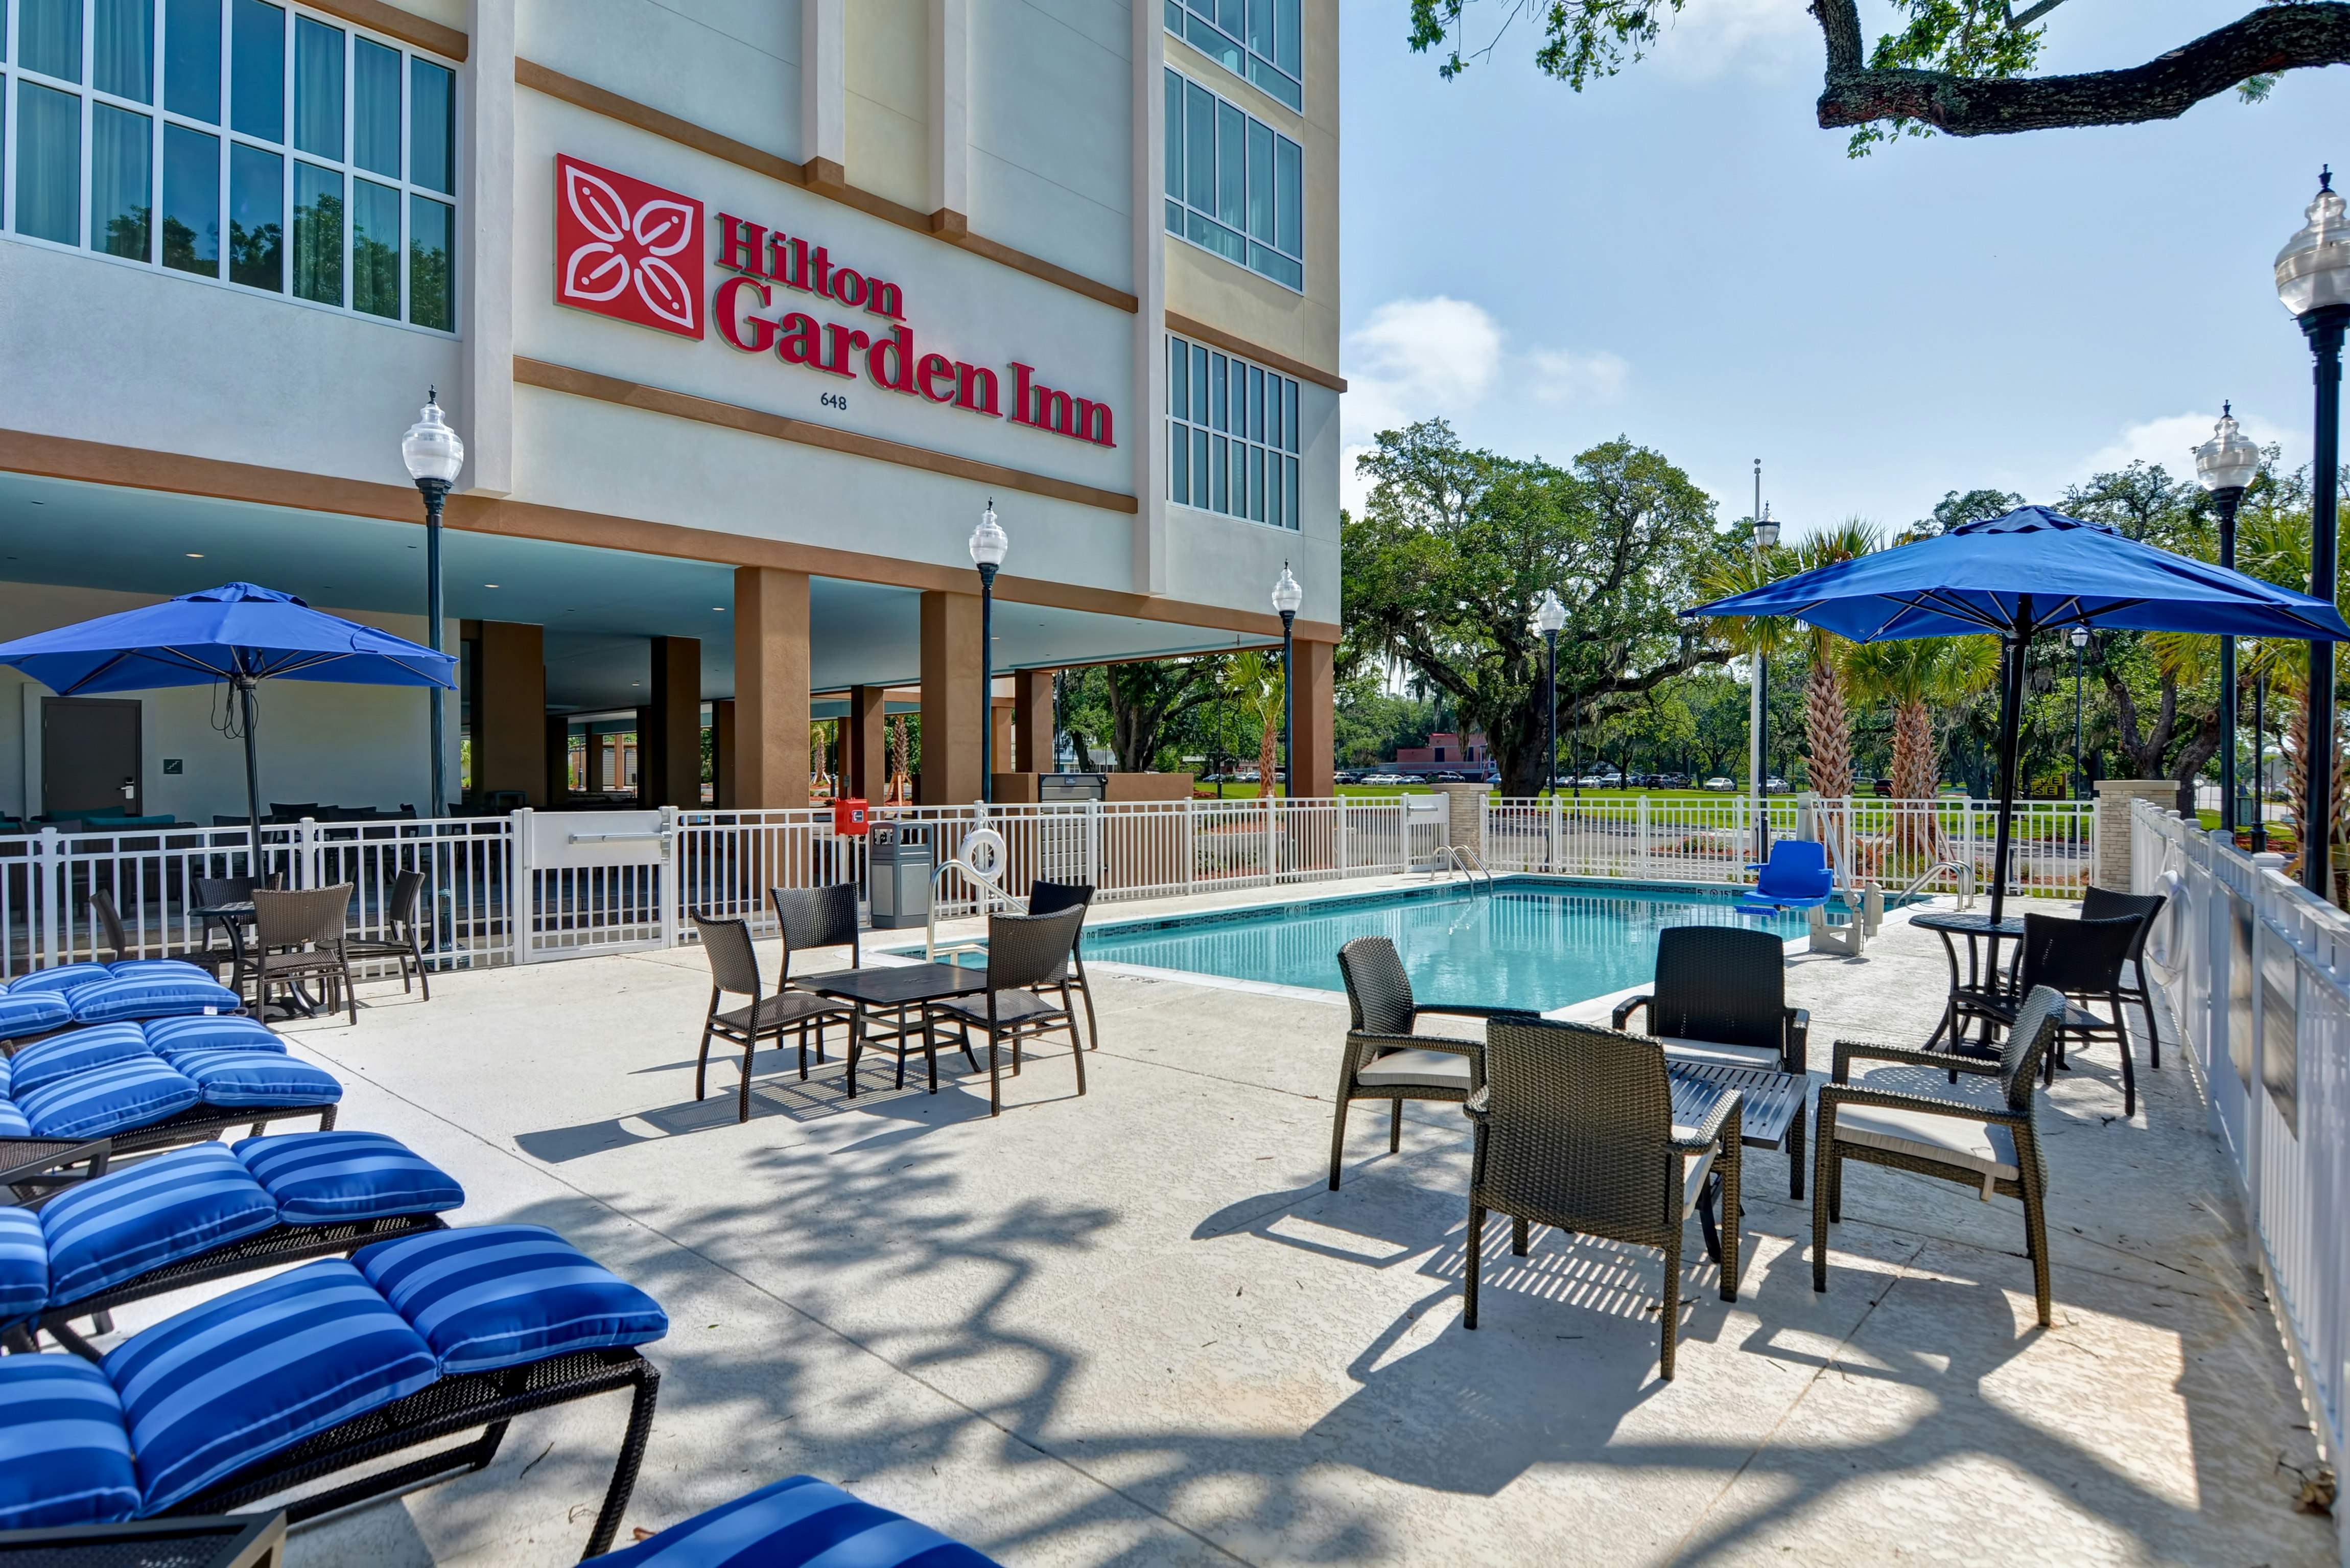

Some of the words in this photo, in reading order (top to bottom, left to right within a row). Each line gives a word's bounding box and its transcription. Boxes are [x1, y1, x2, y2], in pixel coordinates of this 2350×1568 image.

[714, 212, 906, 322] Hilton
[712, 276, 1003, 419] Garden
[1007, 361, 1117, 449] Inn
[820, 392, 847, 410] 648
